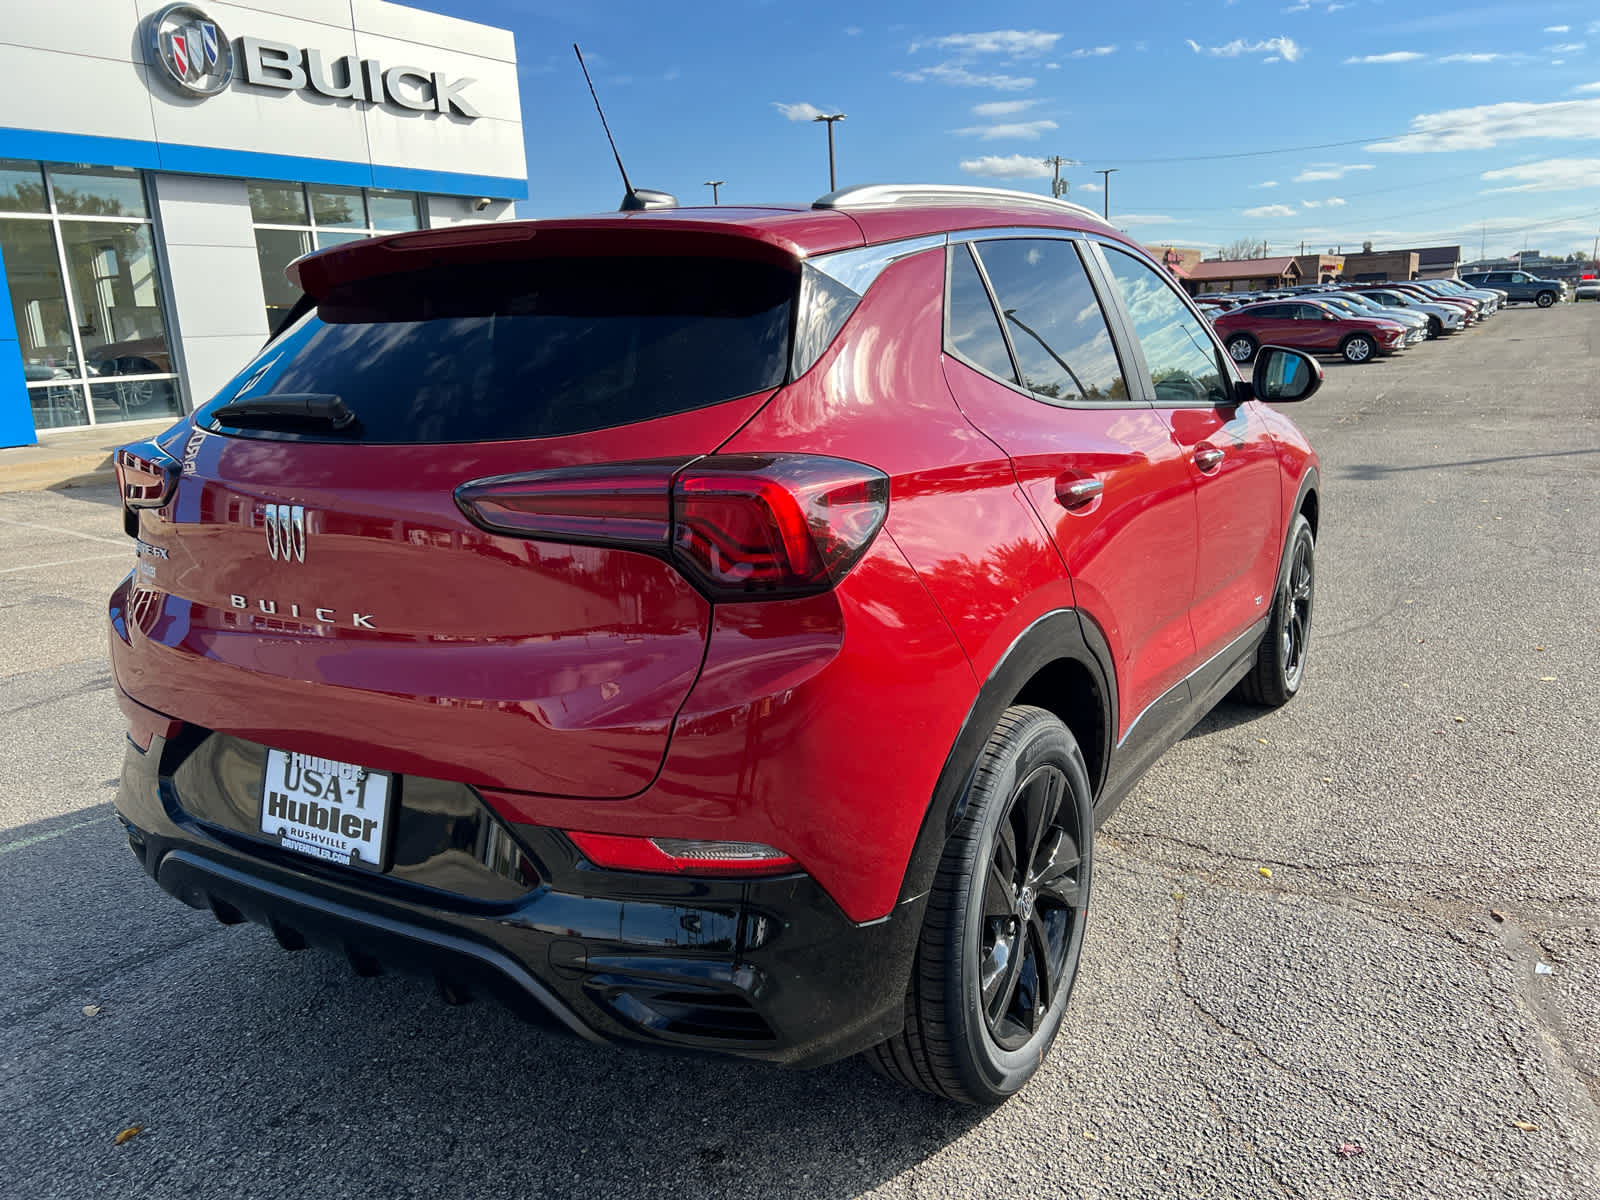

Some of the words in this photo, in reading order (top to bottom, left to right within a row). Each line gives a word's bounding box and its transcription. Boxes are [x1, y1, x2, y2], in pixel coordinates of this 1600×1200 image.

[238, 36, 481, 118] BUICK
[231, 594, 376, 629] BUICK
[284, 763, 367, 809] USA-1
[268, 791, 377, 842] Hubler
[281, 837, 350, 866] DRIVEHUBLER.COM
[290, 827, 348, 850] RUSHVILLE
